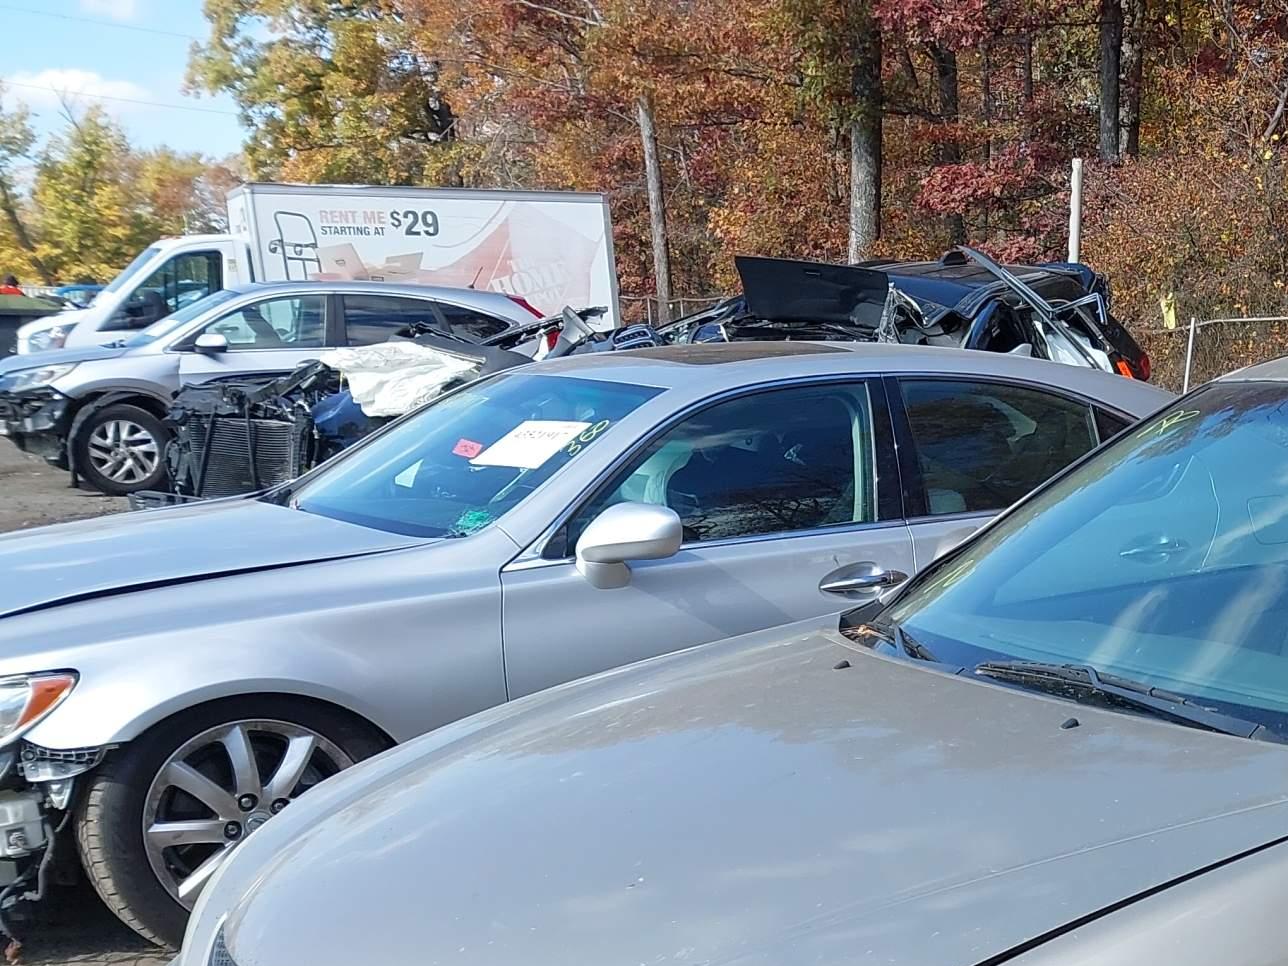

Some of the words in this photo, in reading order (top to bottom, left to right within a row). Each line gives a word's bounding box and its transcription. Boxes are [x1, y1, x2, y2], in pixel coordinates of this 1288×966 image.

[319, 209, 357, 224] RENT
[363, 210, 386, 225] ME
[389, 208, 439, 237] $29
[320, 226, 370, 236] STARTING
[373, 227, 385, 237] AT
